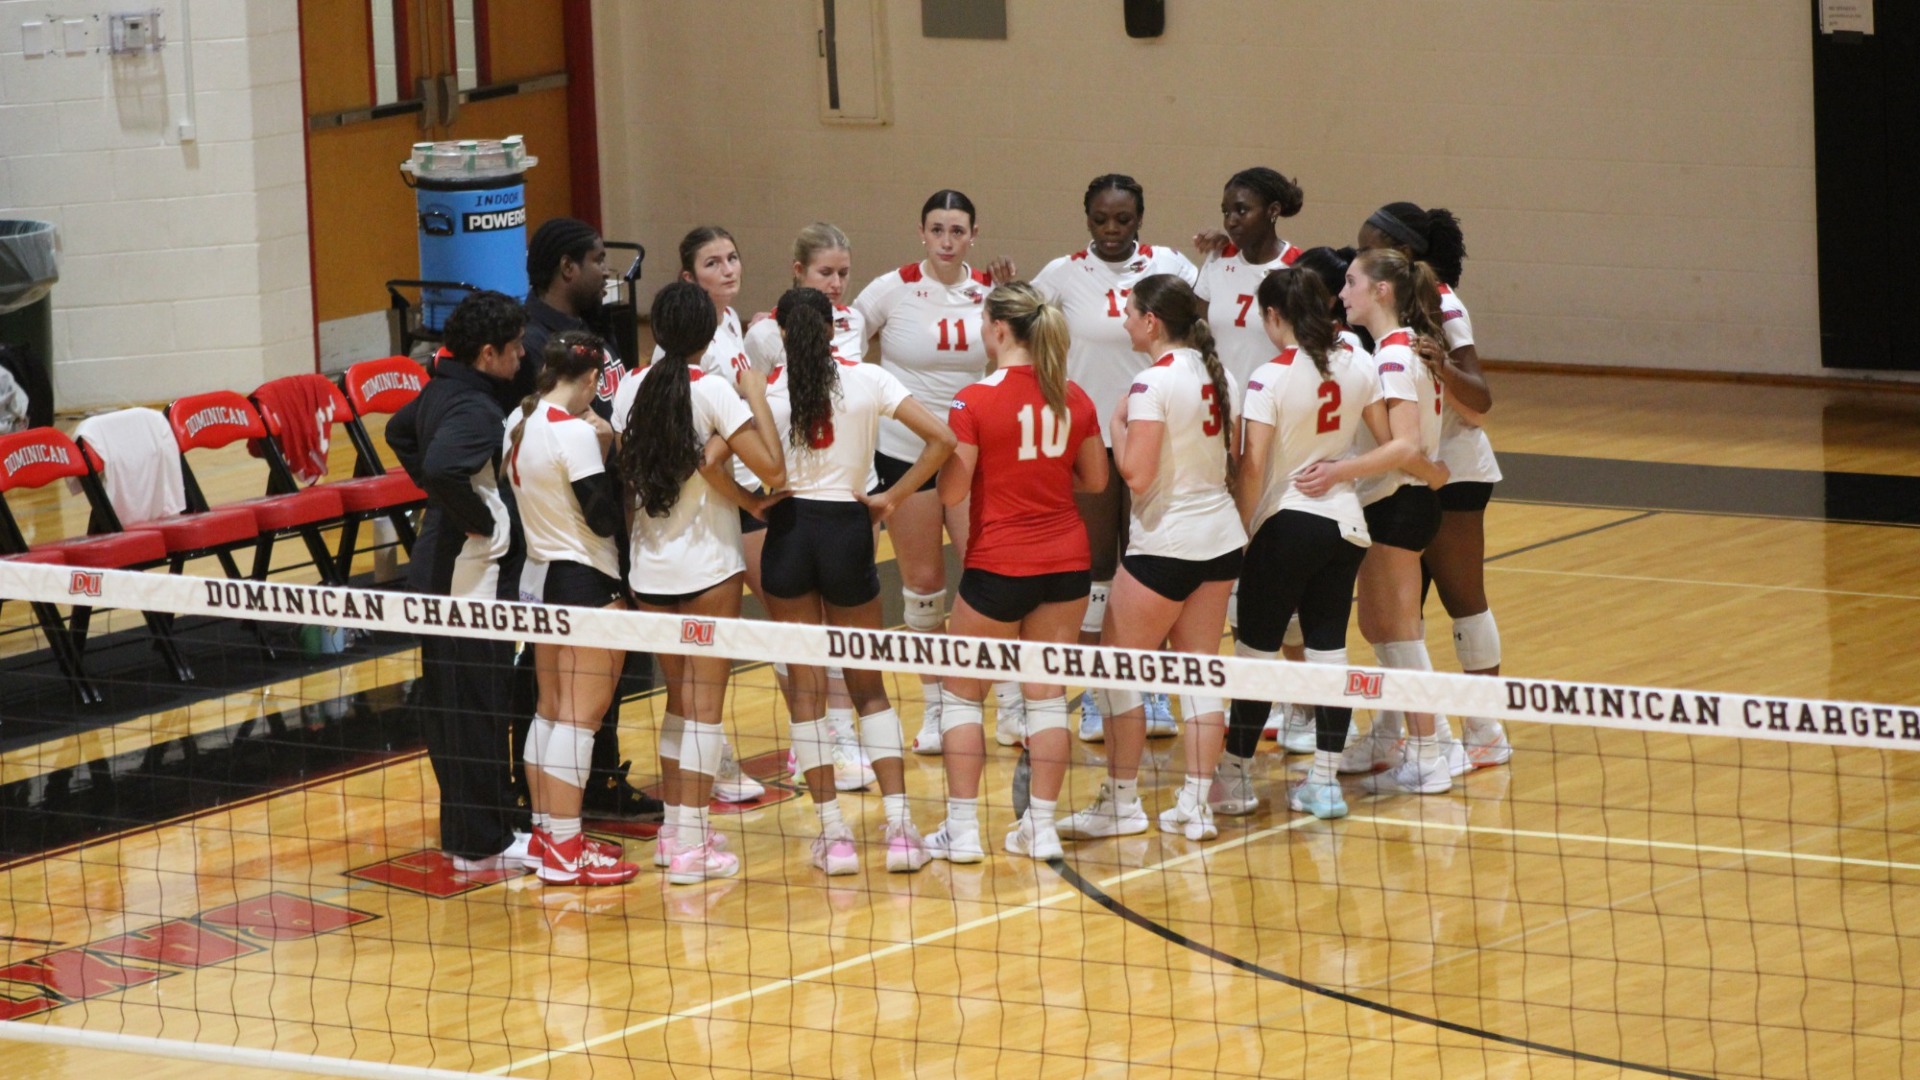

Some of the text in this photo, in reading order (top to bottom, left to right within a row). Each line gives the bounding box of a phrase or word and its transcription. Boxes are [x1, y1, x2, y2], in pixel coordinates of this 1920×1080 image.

[1234, 294, 1254, 327] 7
[937, 318, 969, 351] 11
[361, 371, 422, 402] DOMINICAN
[184, 407, 249, 438] DOMINICAN
[1201, 384, 1222, 437] 3
[1316, 380, 1342, 434] 2
[1017, 404, 1072, 461] 10
[4, 444, 70, 477] DOMINICAN
[69, 571, 103, 597] DU
[205, 580, 571, 636] DOMINICAN CHARGERS
[680, 619, 716, 646] DU
[827, 630, 1226, 687] DOMINICAN CHARGERS
[1344, 671, 1384, 698] DU
[1505, 681, 1920, 740] DOMINICAN CHARGER
